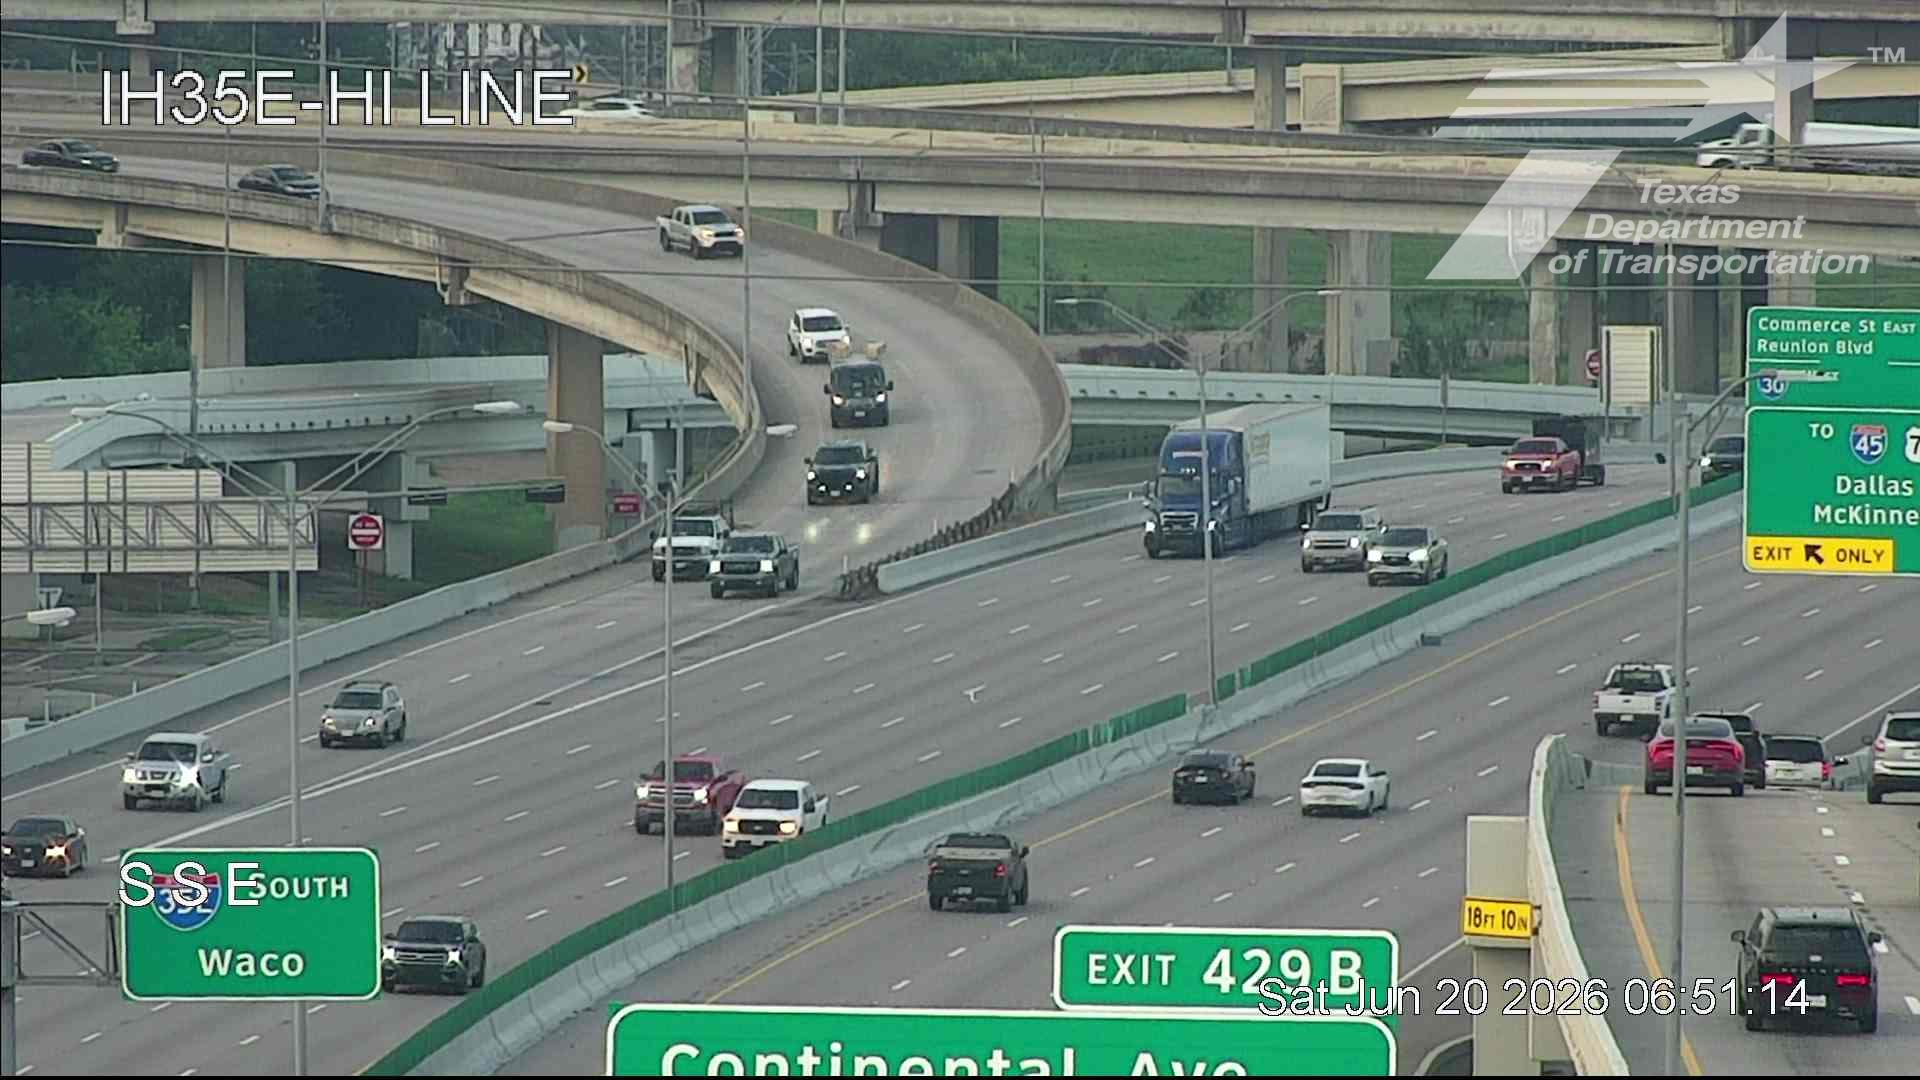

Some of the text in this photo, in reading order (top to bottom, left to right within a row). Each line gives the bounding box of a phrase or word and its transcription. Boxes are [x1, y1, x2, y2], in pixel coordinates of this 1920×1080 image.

[1758, 317, 1916, 334] Commerce St EAST
[1757, 338, 1873, 354] Reunion Blvd
[1760, 376, 1785, 393] 30
[1809, 423, 1834, 439] TO
[1855, 434, 1883, 455] 45
[1836, 475, 1914, 496] Dallas
[1814, 504, 1920, 525] McKinne
[1753, 546, 1885, 563] EXIT ONLY
[249, 873, 348, 898] SOUTH
[198, 949, 304, 976] Waco
[1088, 948, 1364, 996] EXIT 429 B
[661, 1042, 1074, 1076] Continental
